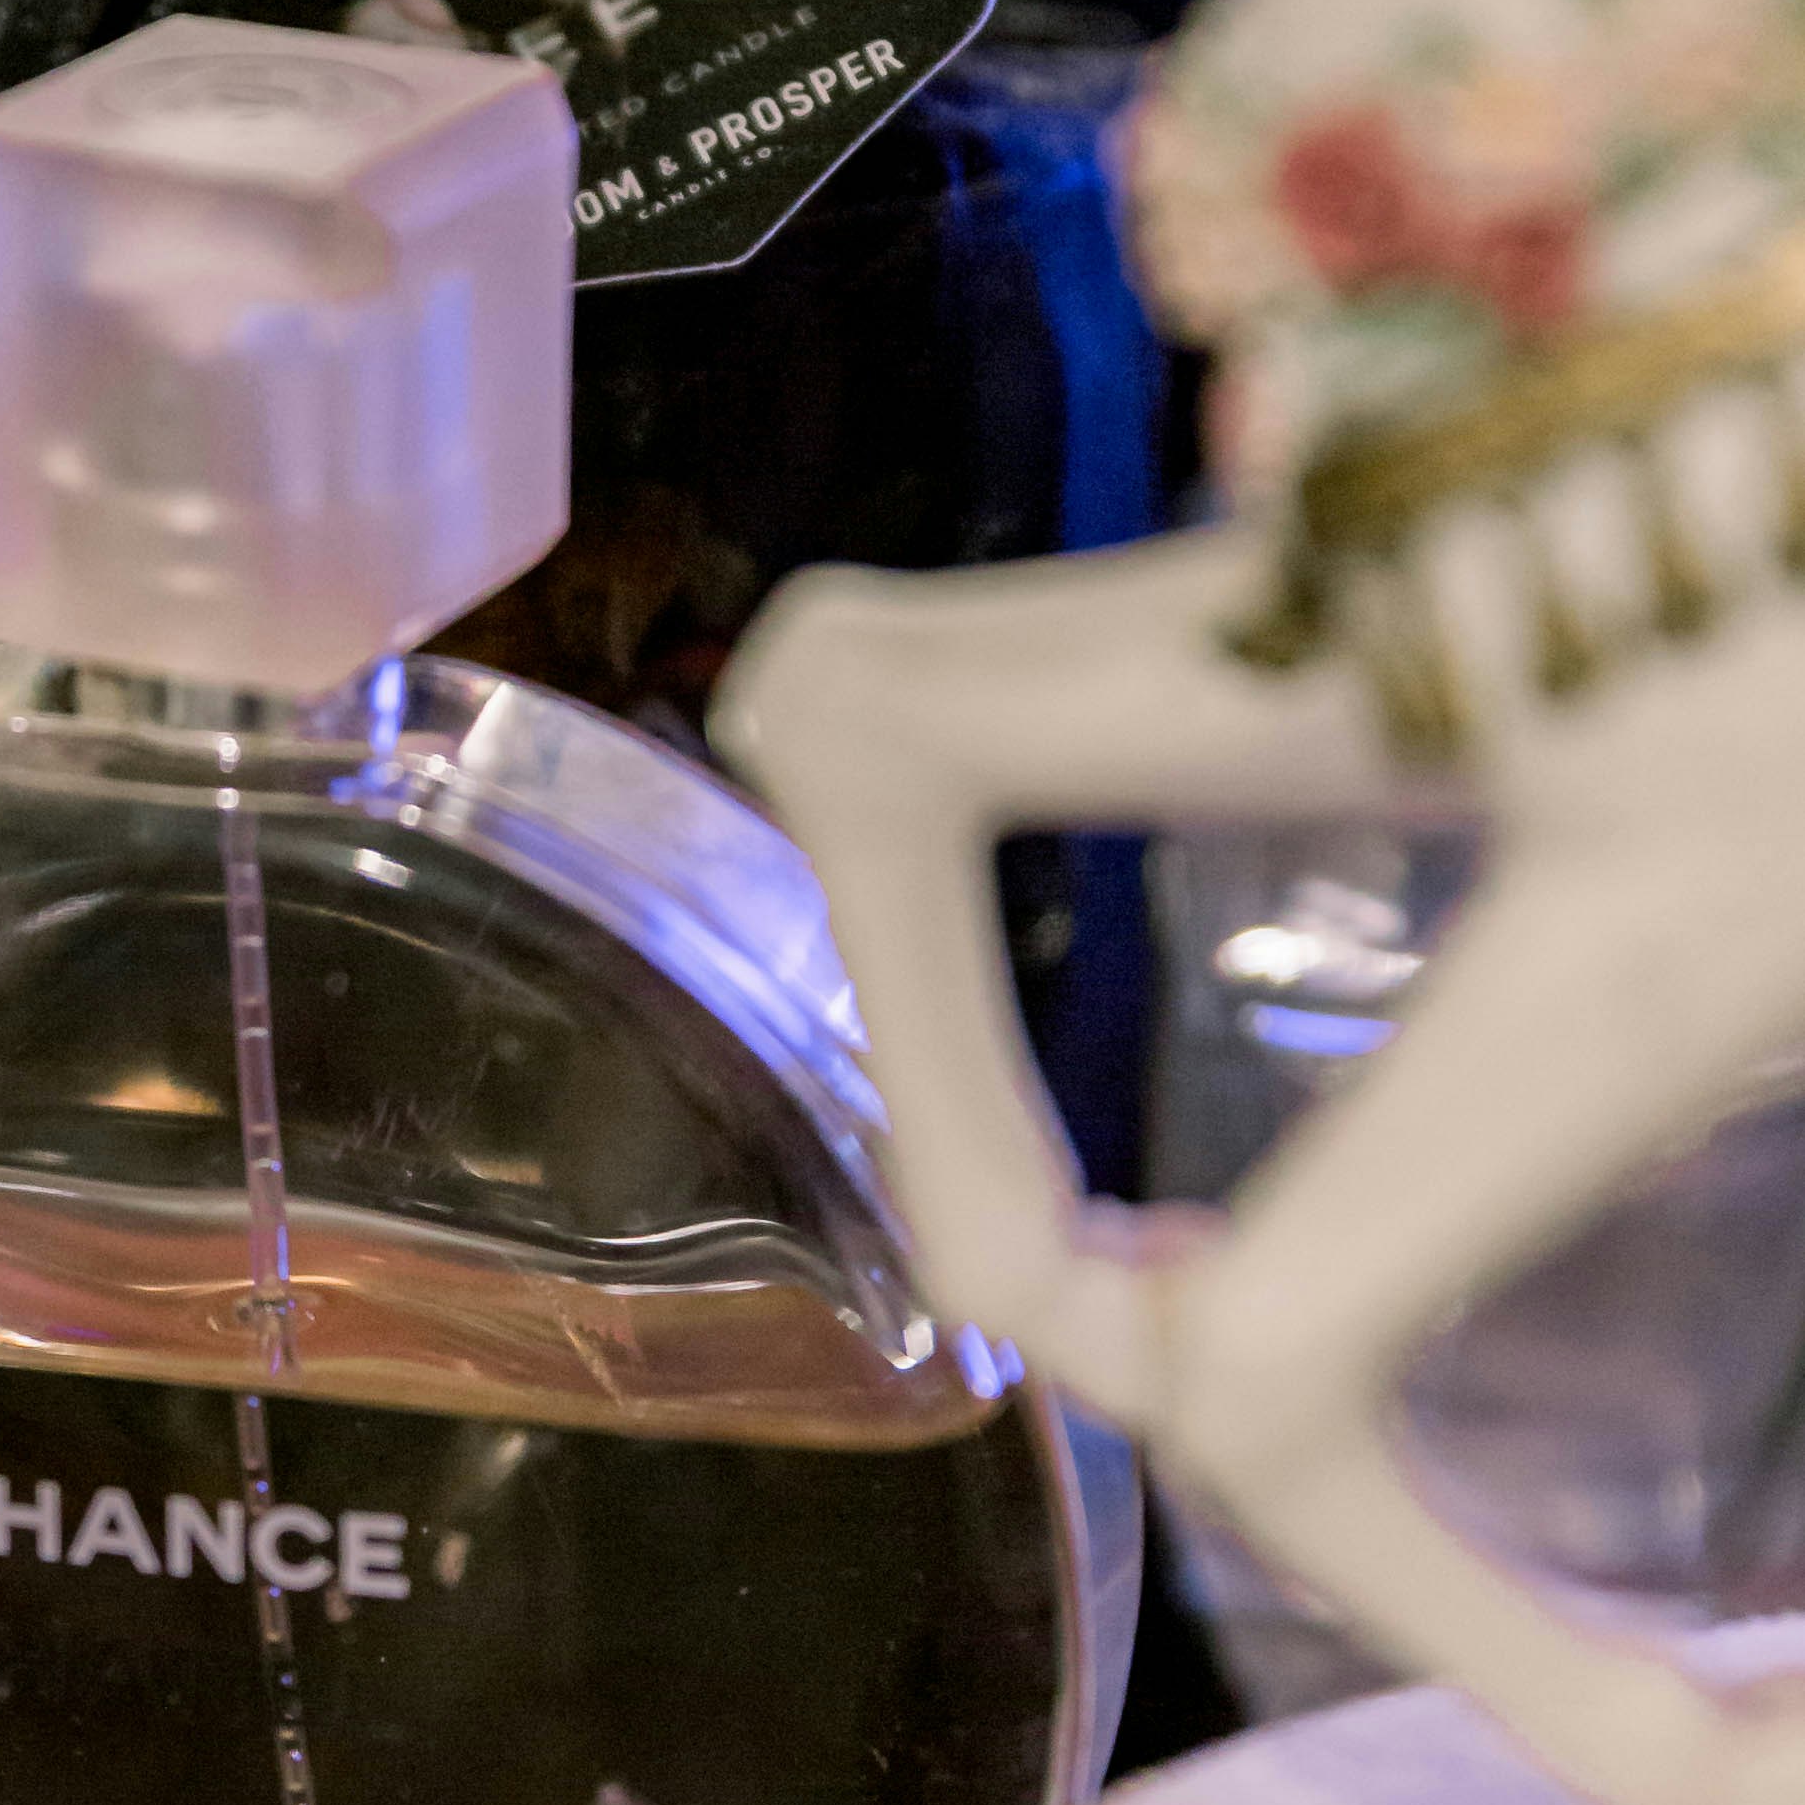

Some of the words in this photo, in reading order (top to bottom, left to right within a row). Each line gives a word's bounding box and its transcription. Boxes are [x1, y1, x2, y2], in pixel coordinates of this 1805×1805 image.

[661, 3, 819, 95] CANDLE
[657, 153, 681, 179] &
[687, 37, 907, 165] PROSPER
[638, 167, 728, 221] CANDLE
